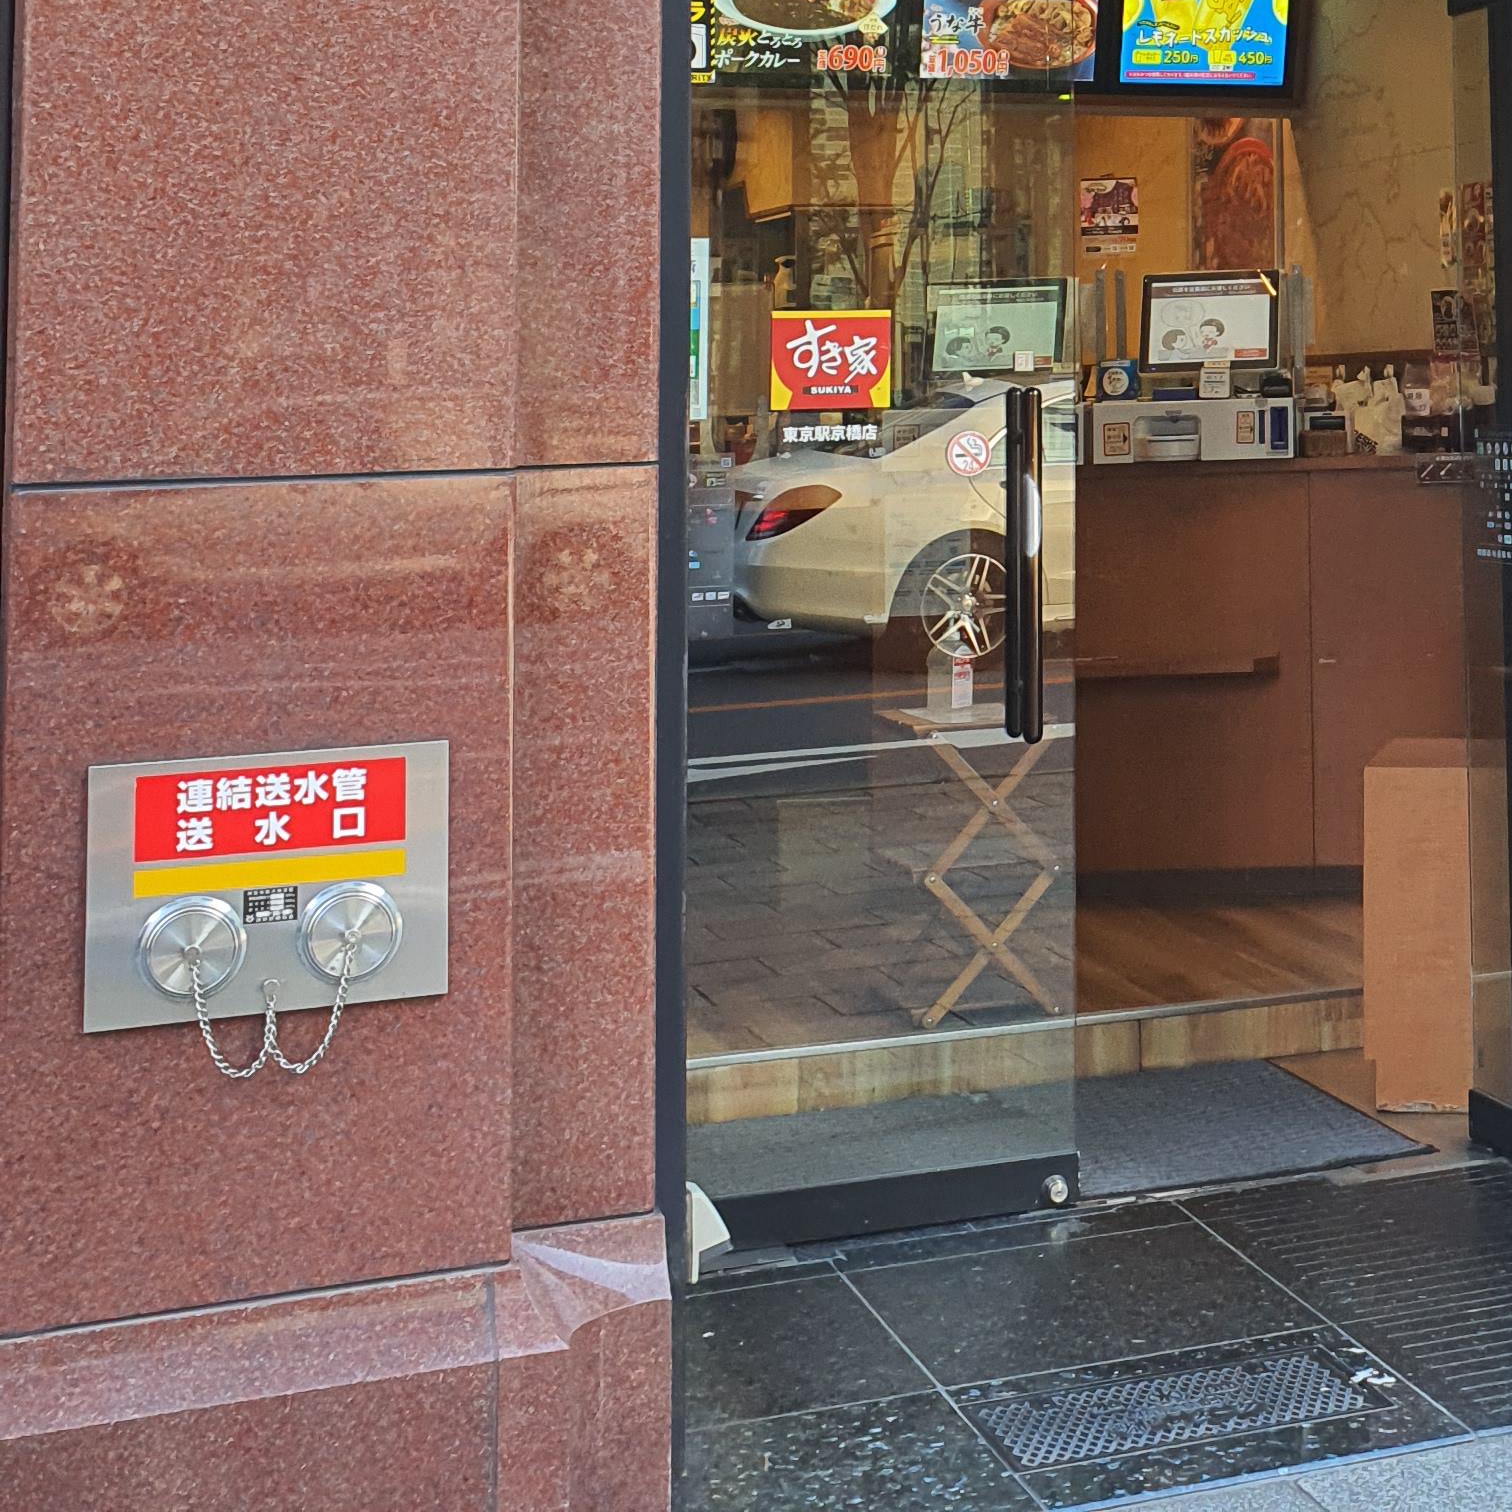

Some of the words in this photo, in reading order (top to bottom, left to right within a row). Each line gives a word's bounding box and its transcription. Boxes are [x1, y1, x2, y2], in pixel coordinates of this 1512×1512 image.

[929, 12, 986, 35] うな牛
[714, 50, 801, 69] ポークカレー
[786, 319, 878, 383] すき家
[810, 386, 852, 395] SUKIYA
[782, 424, 878, 443] 東京駅京橋店
[176, 767, 368, 815] 連結送水管
[176, 806, 366, 852] 送水口
